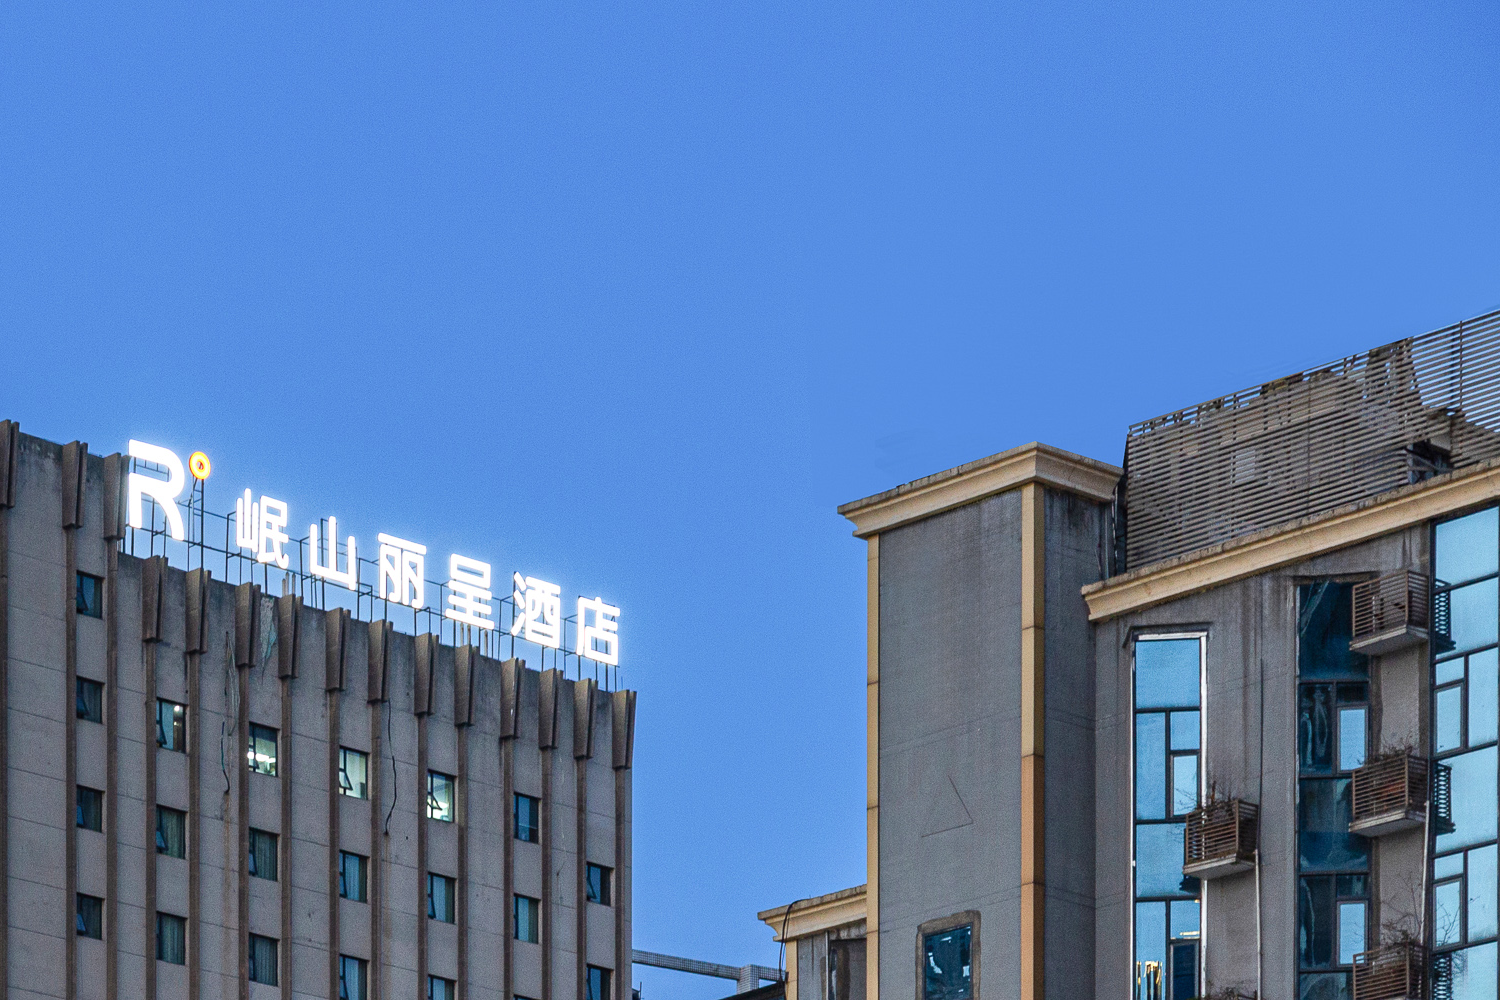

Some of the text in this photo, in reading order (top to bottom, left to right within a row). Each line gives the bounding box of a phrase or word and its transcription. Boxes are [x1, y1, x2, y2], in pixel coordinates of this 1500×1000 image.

[236, 488, 621, 666] 岷山丽呈酒店
